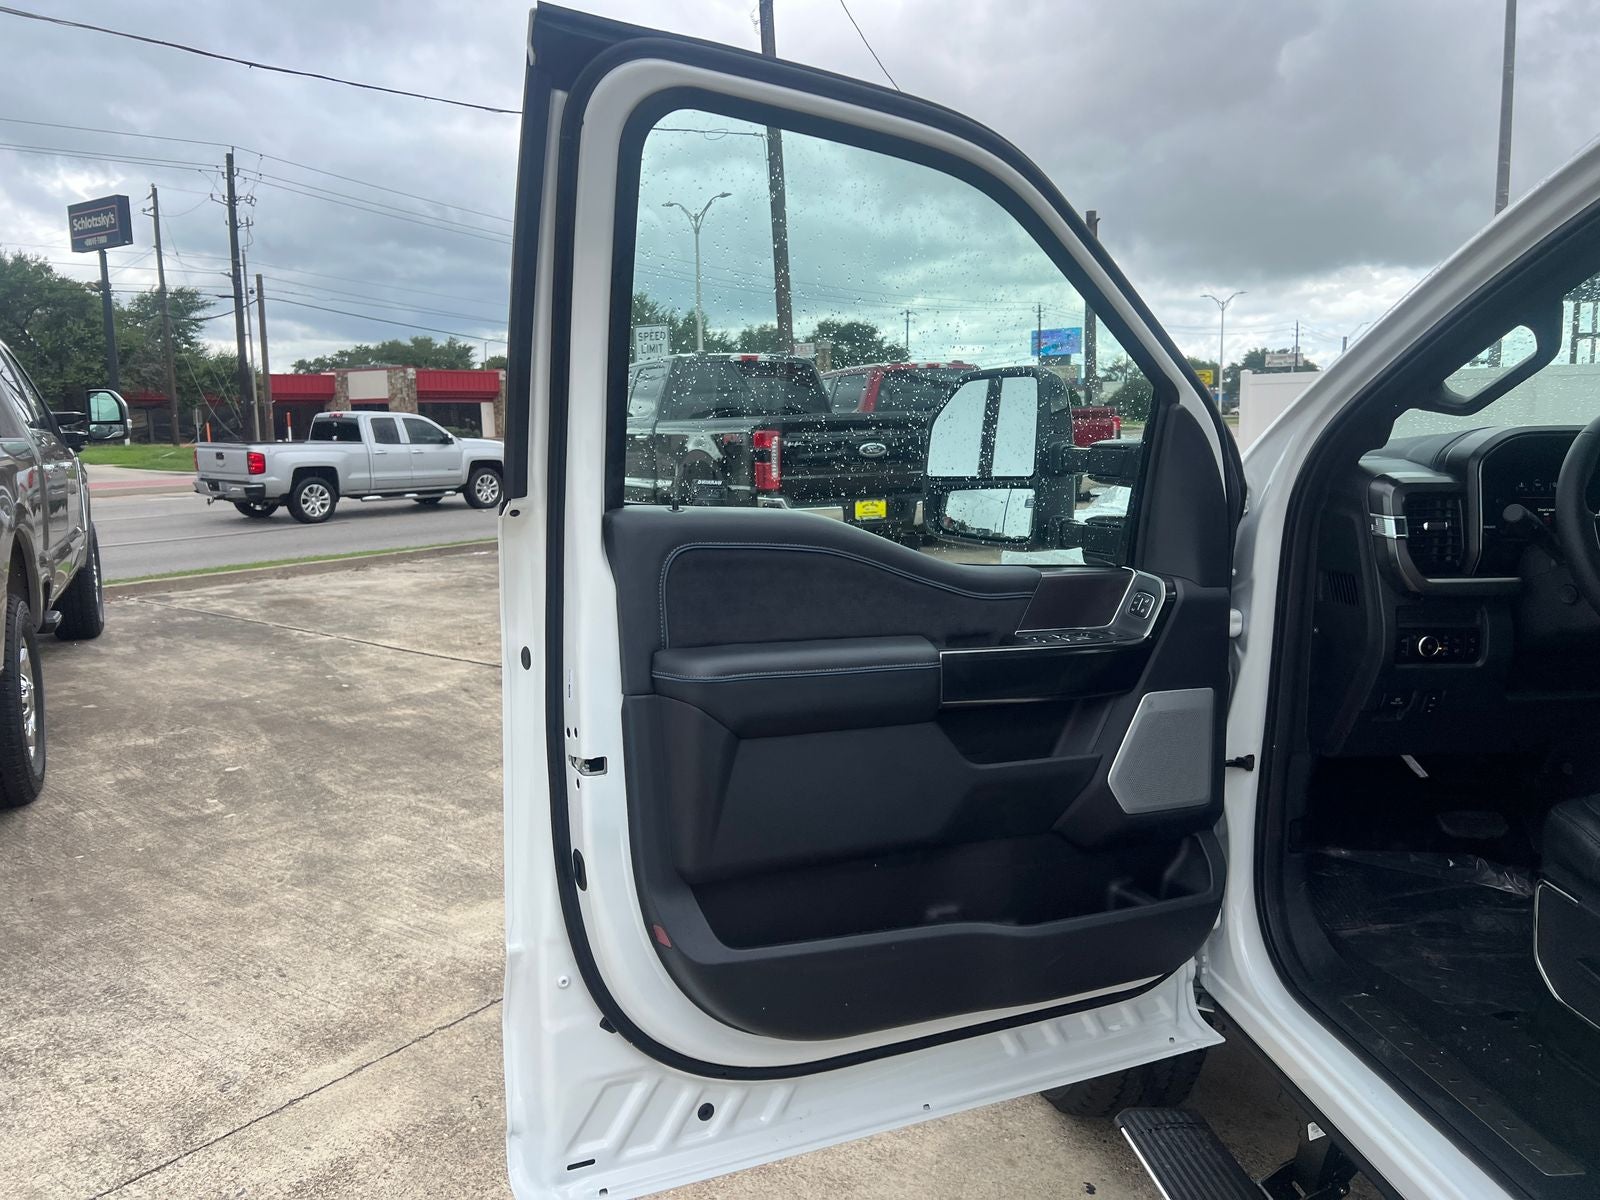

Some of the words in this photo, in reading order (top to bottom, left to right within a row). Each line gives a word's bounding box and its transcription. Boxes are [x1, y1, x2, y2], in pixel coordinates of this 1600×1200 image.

[72, 211, 115, 231] Schlotzsky's
[638, 331, 666, 341] SPEED
[641, 343, 663, 354] LIMIT
